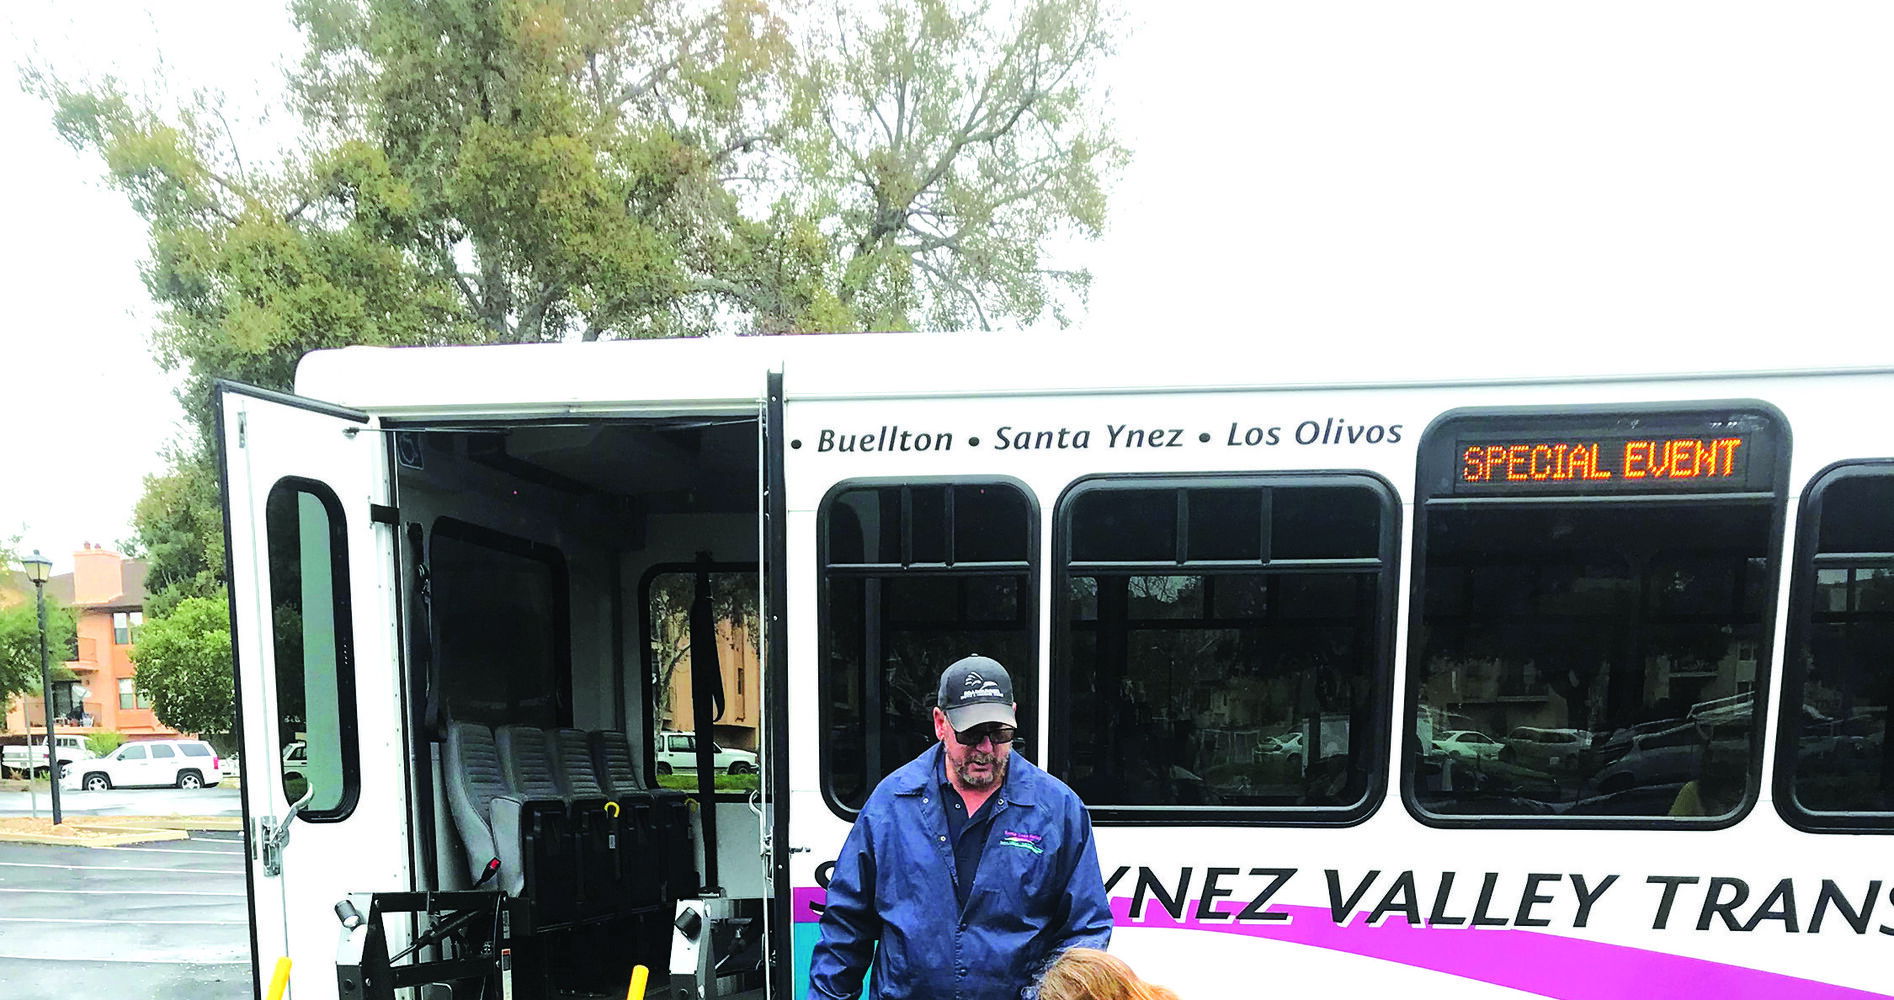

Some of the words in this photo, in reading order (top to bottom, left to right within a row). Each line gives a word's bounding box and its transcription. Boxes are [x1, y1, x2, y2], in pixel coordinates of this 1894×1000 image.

[817, 425, 953, 453] Buellton
[994, 426, 1091, 451] Santa
[1107, 424, 1184, 448] Ynez
[1227, 422, 1281, 447] Los
[1295, 416, 1404, 445] Olivos
[1462, 441, 1611, 482] SPECIAL
[1623, 437, 1743, 479] EVENT
[1324, 869, 1620, 928] VALLEY
